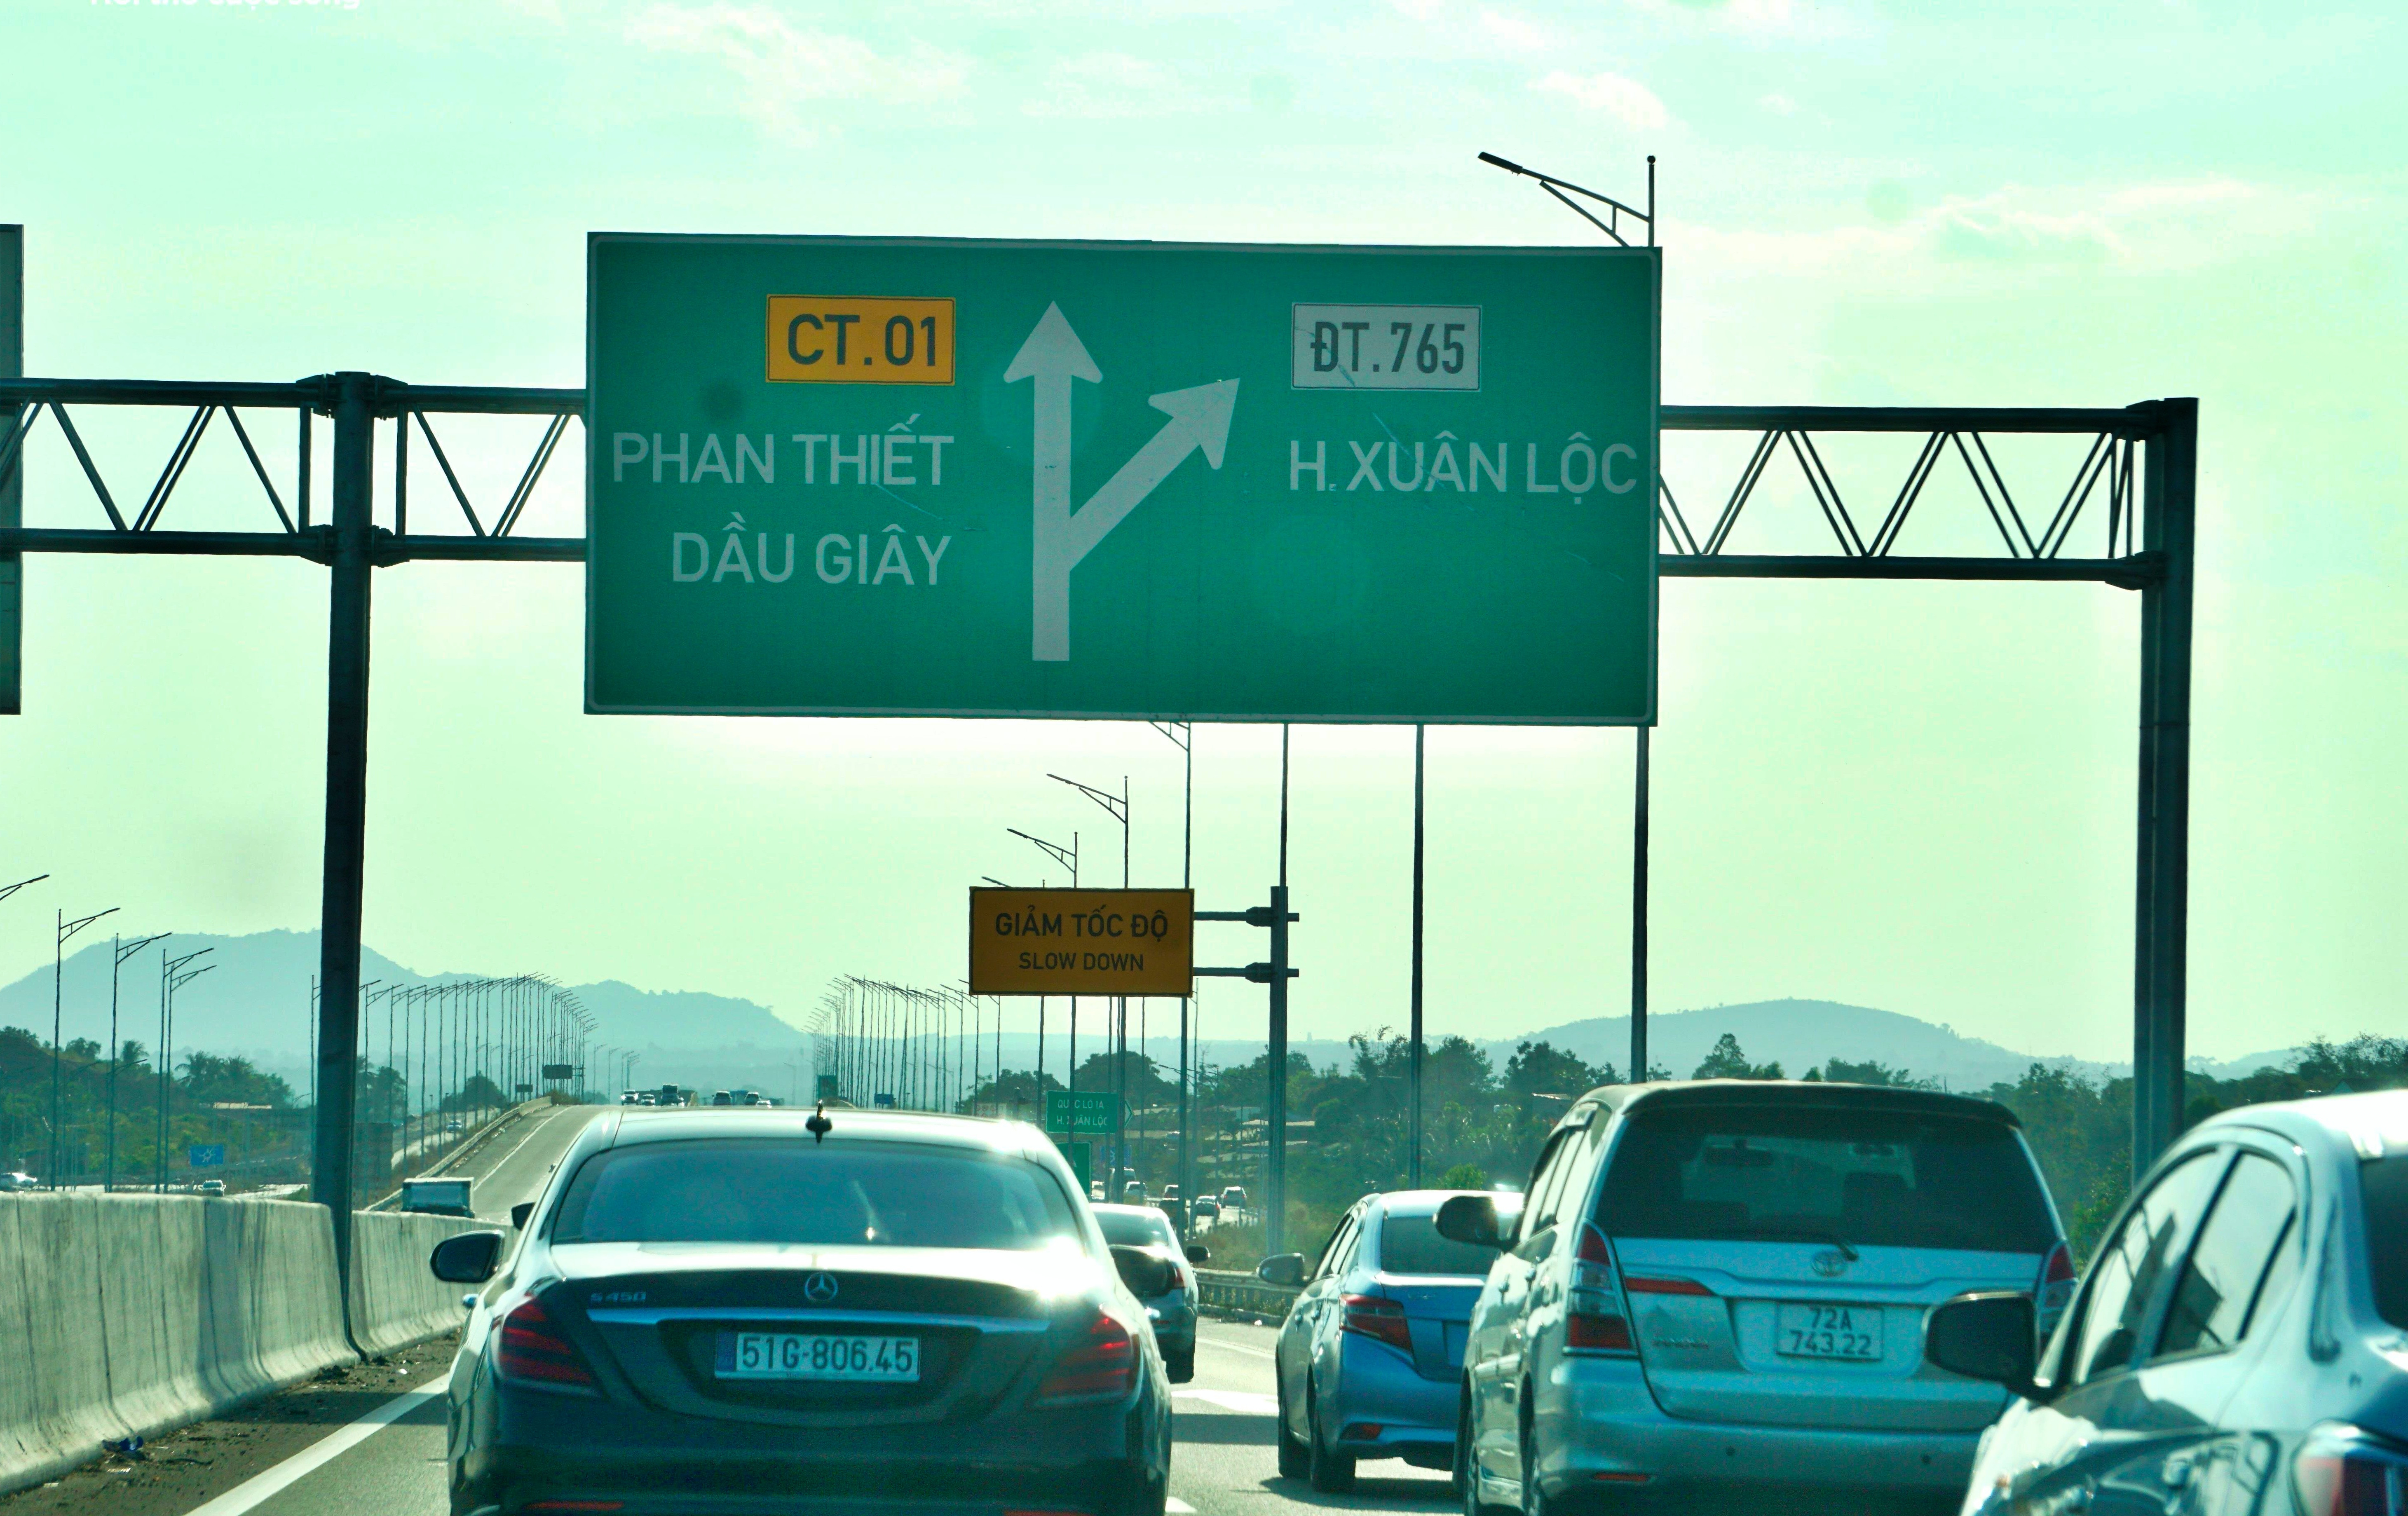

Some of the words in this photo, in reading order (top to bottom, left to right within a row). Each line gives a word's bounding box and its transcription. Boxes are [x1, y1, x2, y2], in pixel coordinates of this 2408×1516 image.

[788, 313, 936, 366] CT.01
[1310, 321, 1465, 374] ĐT.765
[613, 432, 774, 483] PHAN
[792, 413, 954, 485] THIẾT
[1526, 431, 1638, 505] LỘC
[673, 512, 795, 583] DẦU
[815, 523, 952, 585] GIÂY
[995, 904, 1062, 936] GIẢM
[1071, 904, 1123, 937] TỐC
[1130, 909, 1168, 942] ĐỘ
[1019, 952, 1076, 970] SLOW
[1083, 953, 1144, 971] DOWN
[1058, 1099, 1080, 1108] QUC
[1809, 1307, 1852, 1330] 72A
[742, 1336, 913, 1372] 51G-806.45
[1789, 1330, 1871, 1355] 743.22
